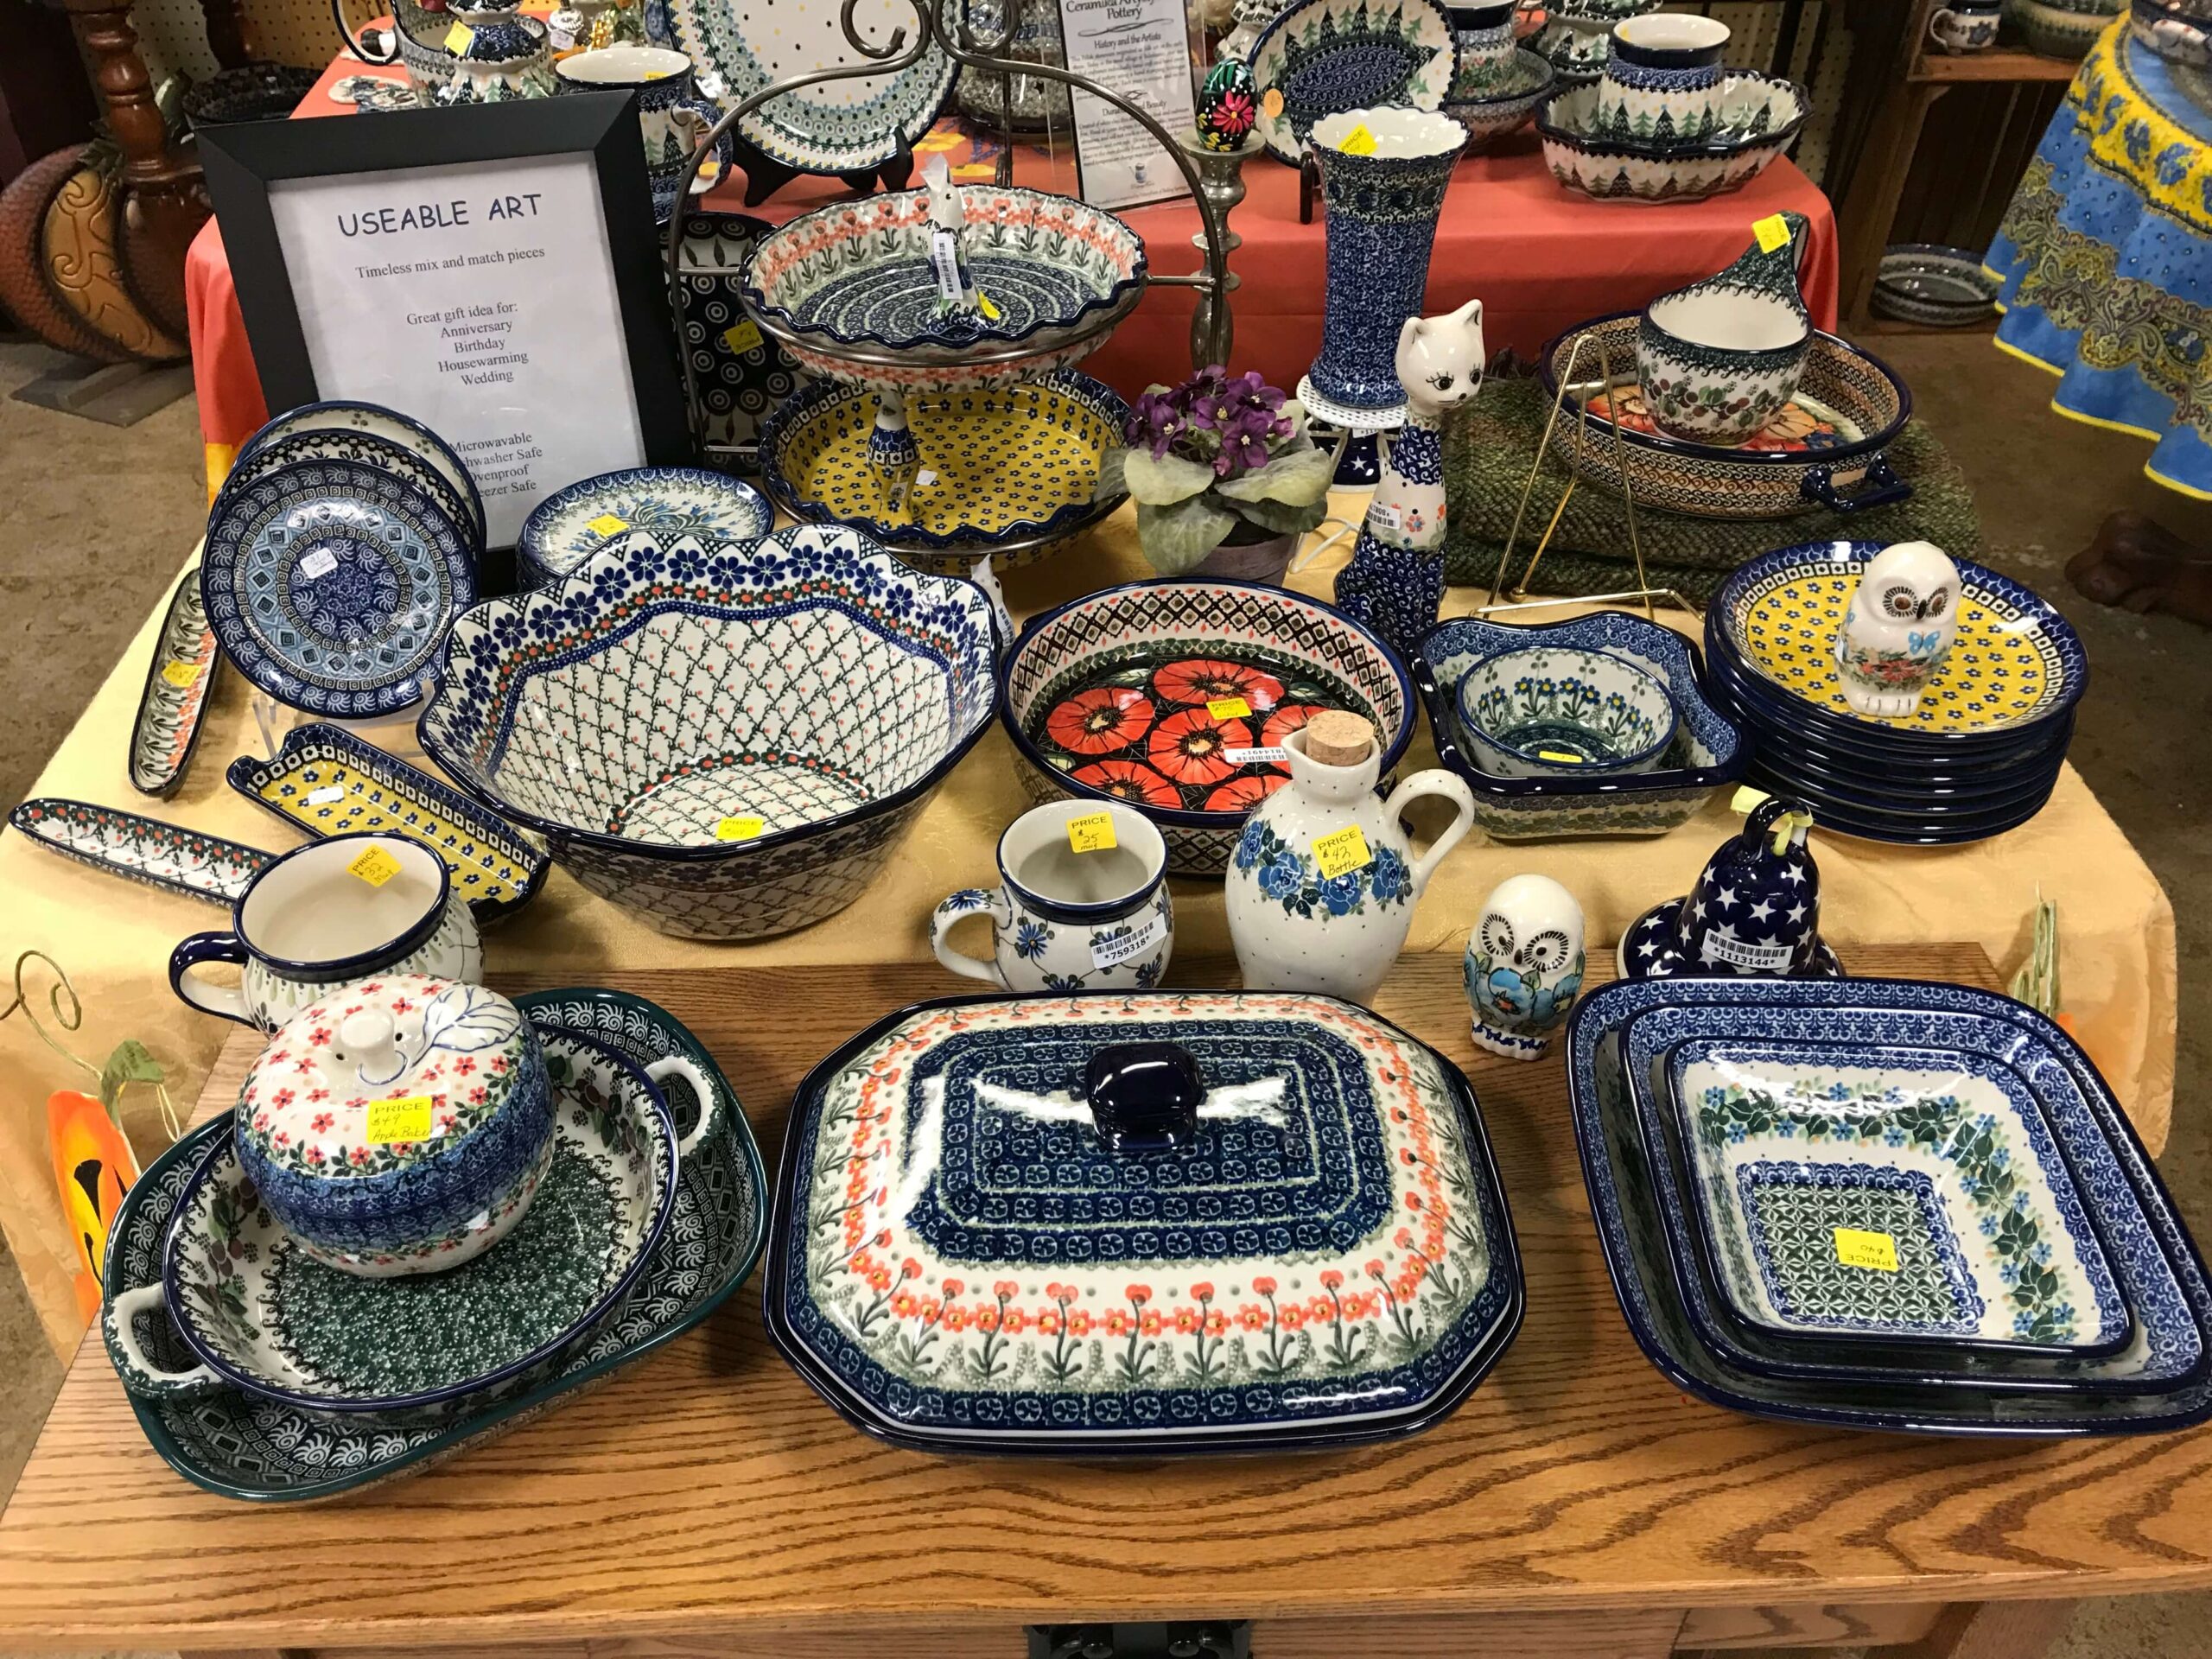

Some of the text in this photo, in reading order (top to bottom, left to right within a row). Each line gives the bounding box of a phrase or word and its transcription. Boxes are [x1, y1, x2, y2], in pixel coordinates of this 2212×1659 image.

[1107, 7, 1142, 20] Pottery
[1094, 39, 1116, 49] History
[1117, 37, 1129, 46] and
[338, 194, 542, 237] USEABLE ART
[355, 247, 545, 279] Timeless mix and match pieces
[407, 302, 518, 325] Great gift idea for:
[441, 321, 513, 339] Anniversary
[454, 337, 505, 353] Birthday
[438, 352, 529, 373] Housewarming
[461, 370, 514, 386] Wedding
[449, 432, 532, 453] Microwavable
[517, 446, 543, 460] Safe
[478, 480, 537, 499] eezer Safe
[1071, 817, 1107, 830] PRICE
[1318, 830, 1357, 851] PRICE
[352, 848, 380, 872] PRICE
[1327, 860, 1363, 876] Bottle
[374, 1103, 424, 1114] PRICE
[372, 1128, 397, 1141] Apple
[1845, 1254, 1891, 1267] PRICE
